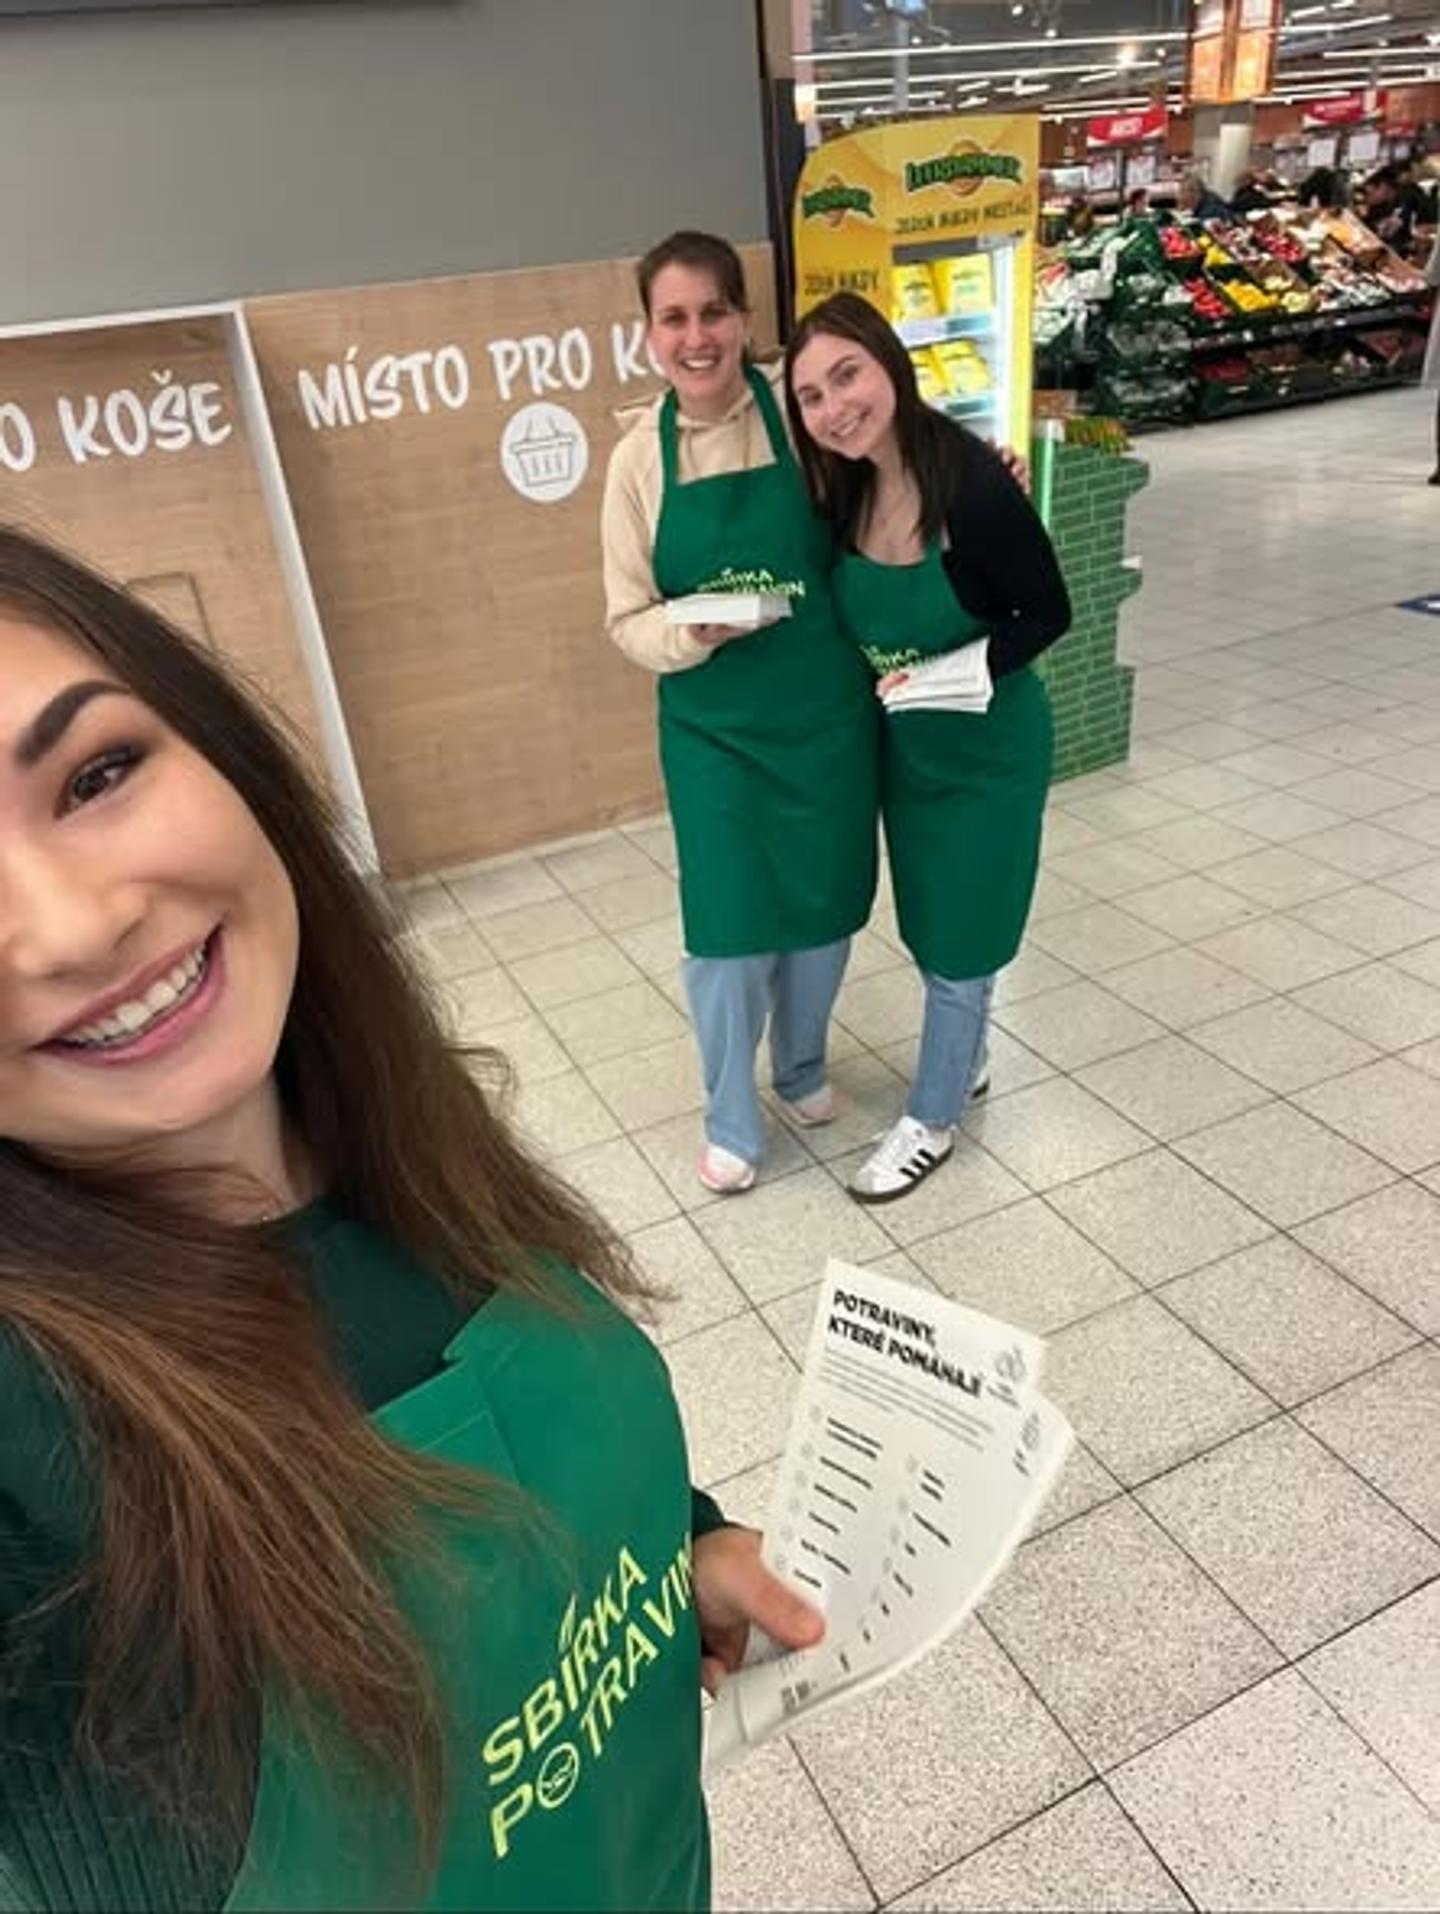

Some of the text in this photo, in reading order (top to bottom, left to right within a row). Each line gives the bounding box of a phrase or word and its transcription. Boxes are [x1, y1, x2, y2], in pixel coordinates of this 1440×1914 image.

[58, 369, 232, 463] KOŠE
[299, 346, 470, 429] MÍSTO
[488, 327, 592, 399] PRO
[827, 1314, 888, 1354] KTERÉ
[482, 1545, 648, 1786] SBÍRKA
